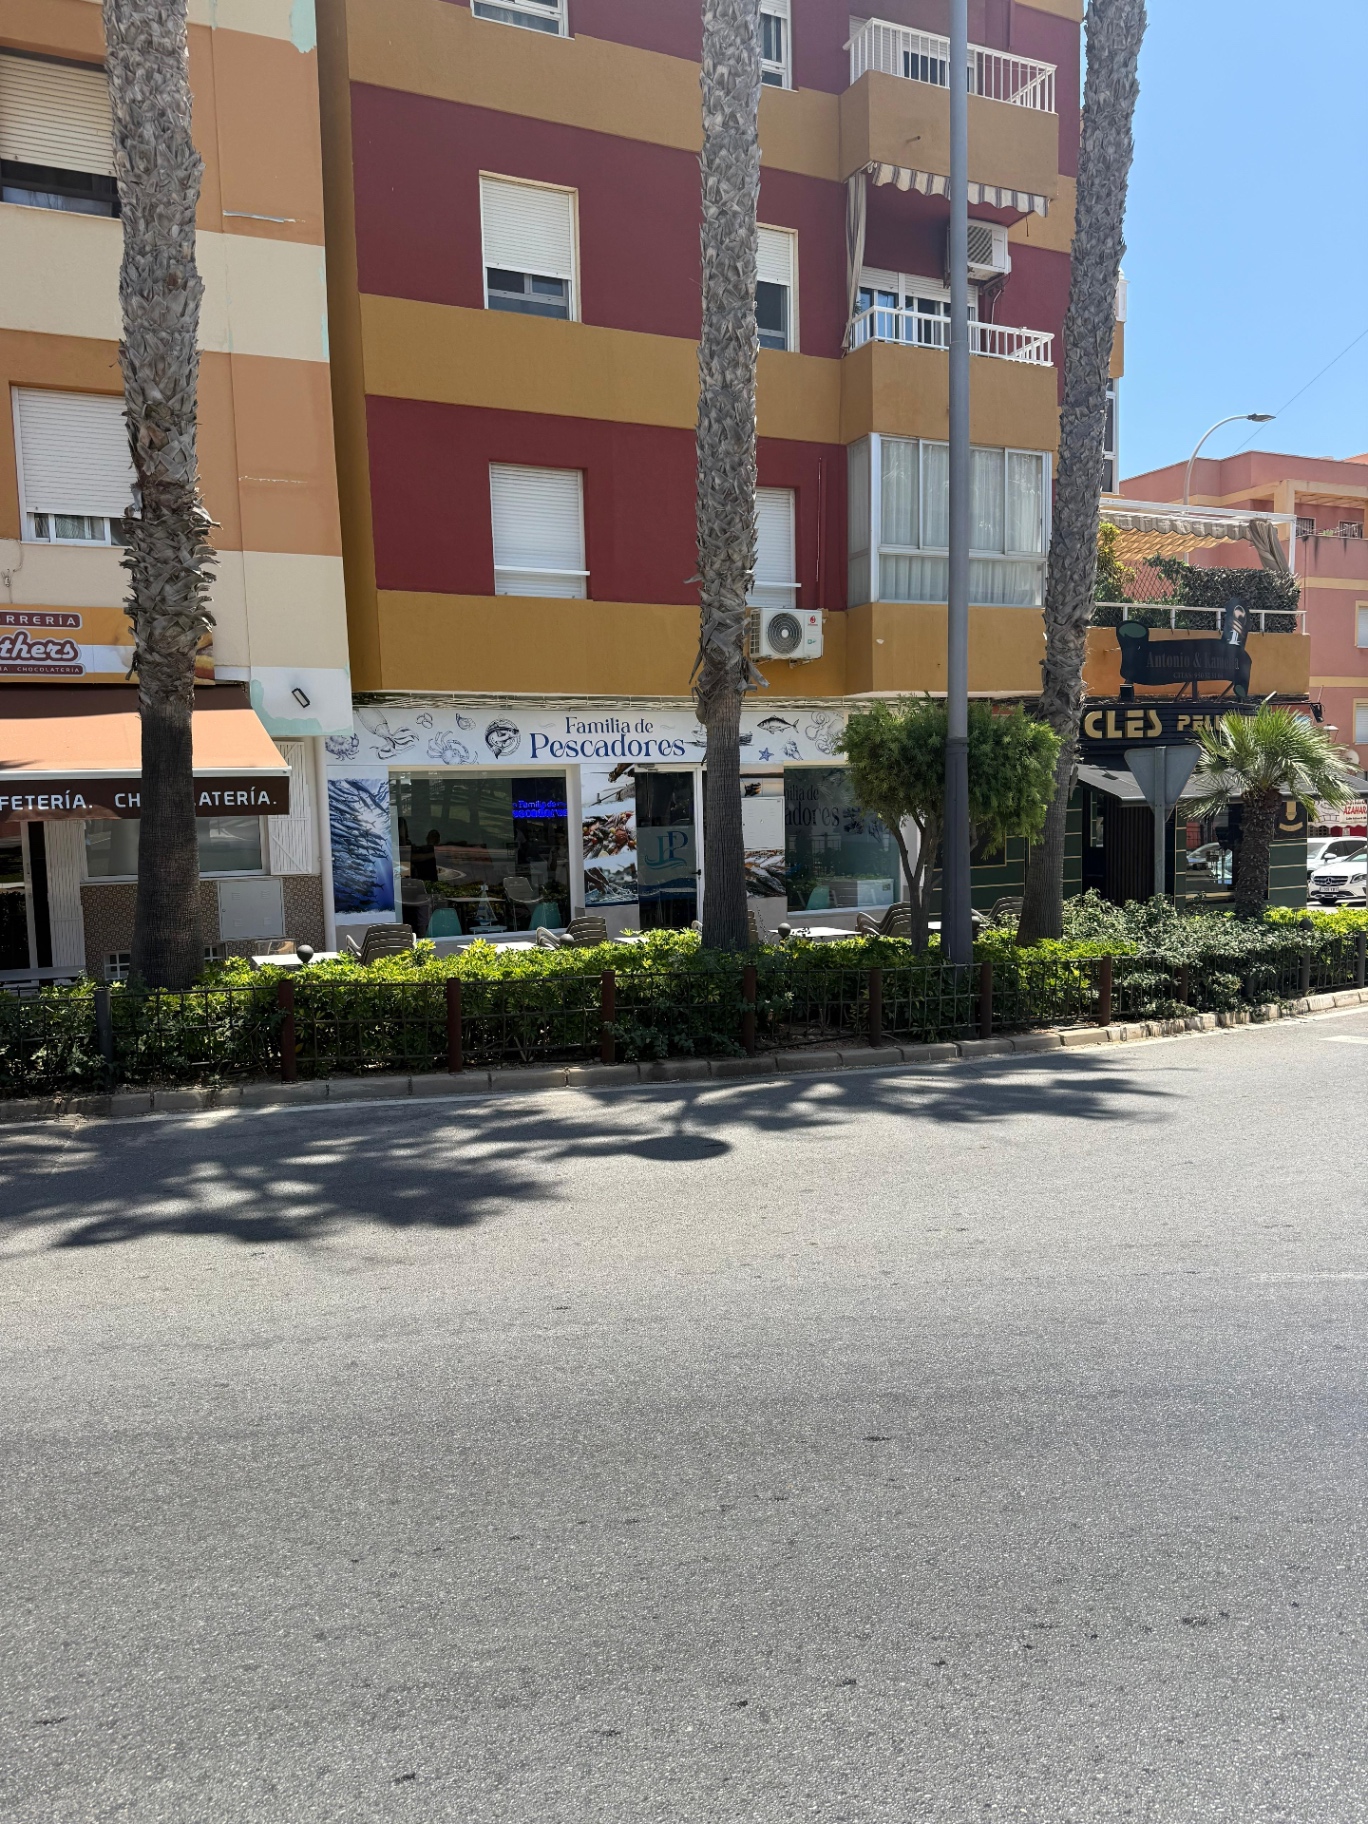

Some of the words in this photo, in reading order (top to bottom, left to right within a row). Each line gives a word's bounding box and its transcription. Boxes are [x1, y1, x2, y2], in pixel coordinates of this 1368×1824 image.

[6, 615, 76, 626] RRERÍA
[0, 634, 75, 658] thers
[1193, 652, 1202, 668] &
[565, 716, 631, 734] Familia
[635, 718, 654, 734] de
[529, 733, 686, 758] Pescadores
[114, 786, 277, 808] CHATERÍA.
[806, 785, 819, 801] de
